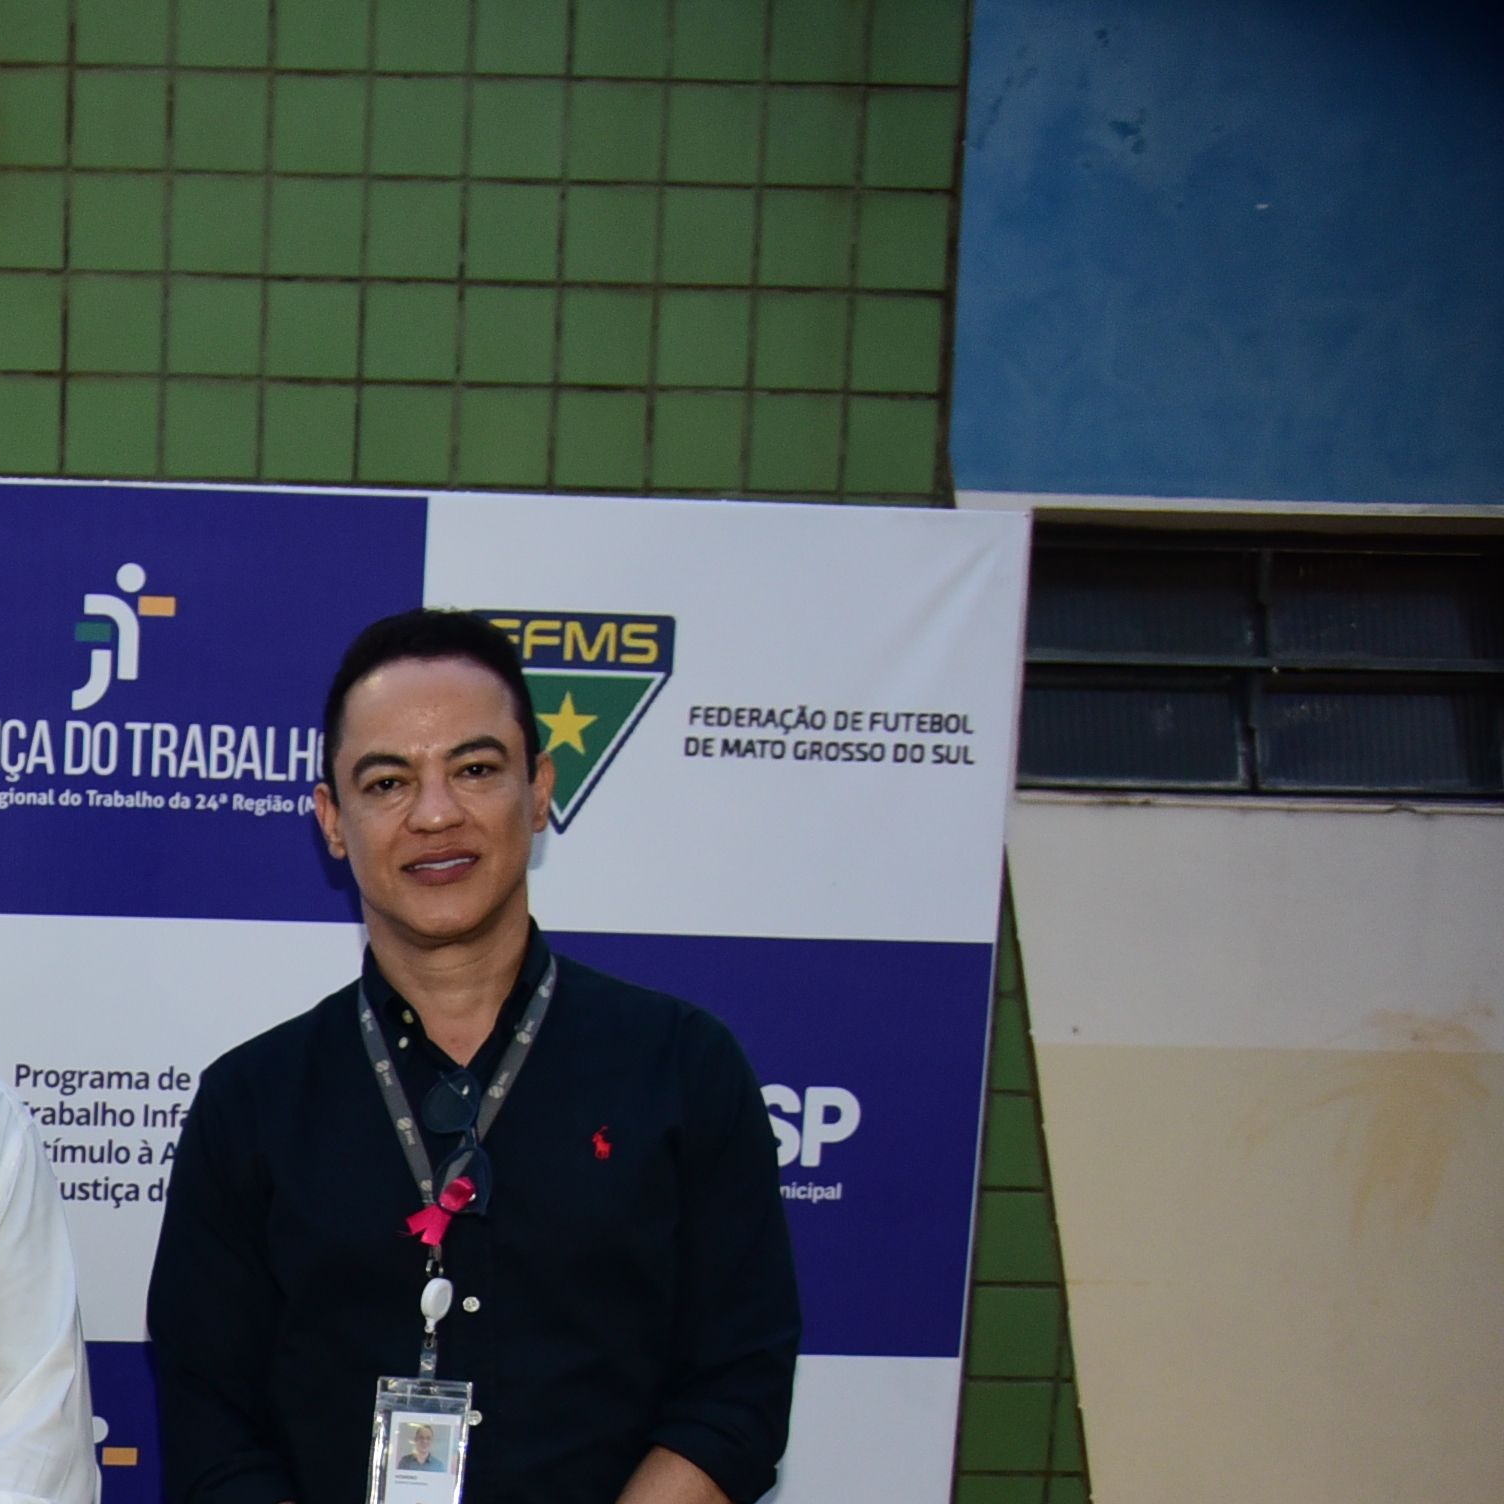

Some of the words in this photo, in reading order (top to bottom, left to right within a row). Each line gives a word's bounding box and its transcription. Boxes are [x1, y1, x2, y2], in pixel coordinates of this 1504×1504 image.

[690, 706, 826, 735] FEDERAÇÃO
[835, 711, 862, 732] DE
[869, 712, 974, 734] FUTEBOL
[64, 720, 117, 776] DO
[684, 737, 713, 757] DE
[720, 738, 786, 759] MATO
[793, 740, 885, 763] GROSSO
[893, 744, 925, 764] DO
[932, 744, 975, 765] SUL
[59, 789, 82, 806] do
[86, 789, 164, 809] Trabalho
[169, 792, 191, 809] da
[195, 794, 227, 810] 24ª
[233, 794, 293, 815] Região
[15, 1064, 149, 1095] Programa
[158, 1066, 191, 1091] de
[22, 1101, 135, 1126] rabalho
[138, 1140, 152, 1164] à
[60, 1177, 139, 1209] ustiça
[780, 1182, 842, 1204] nicipal
